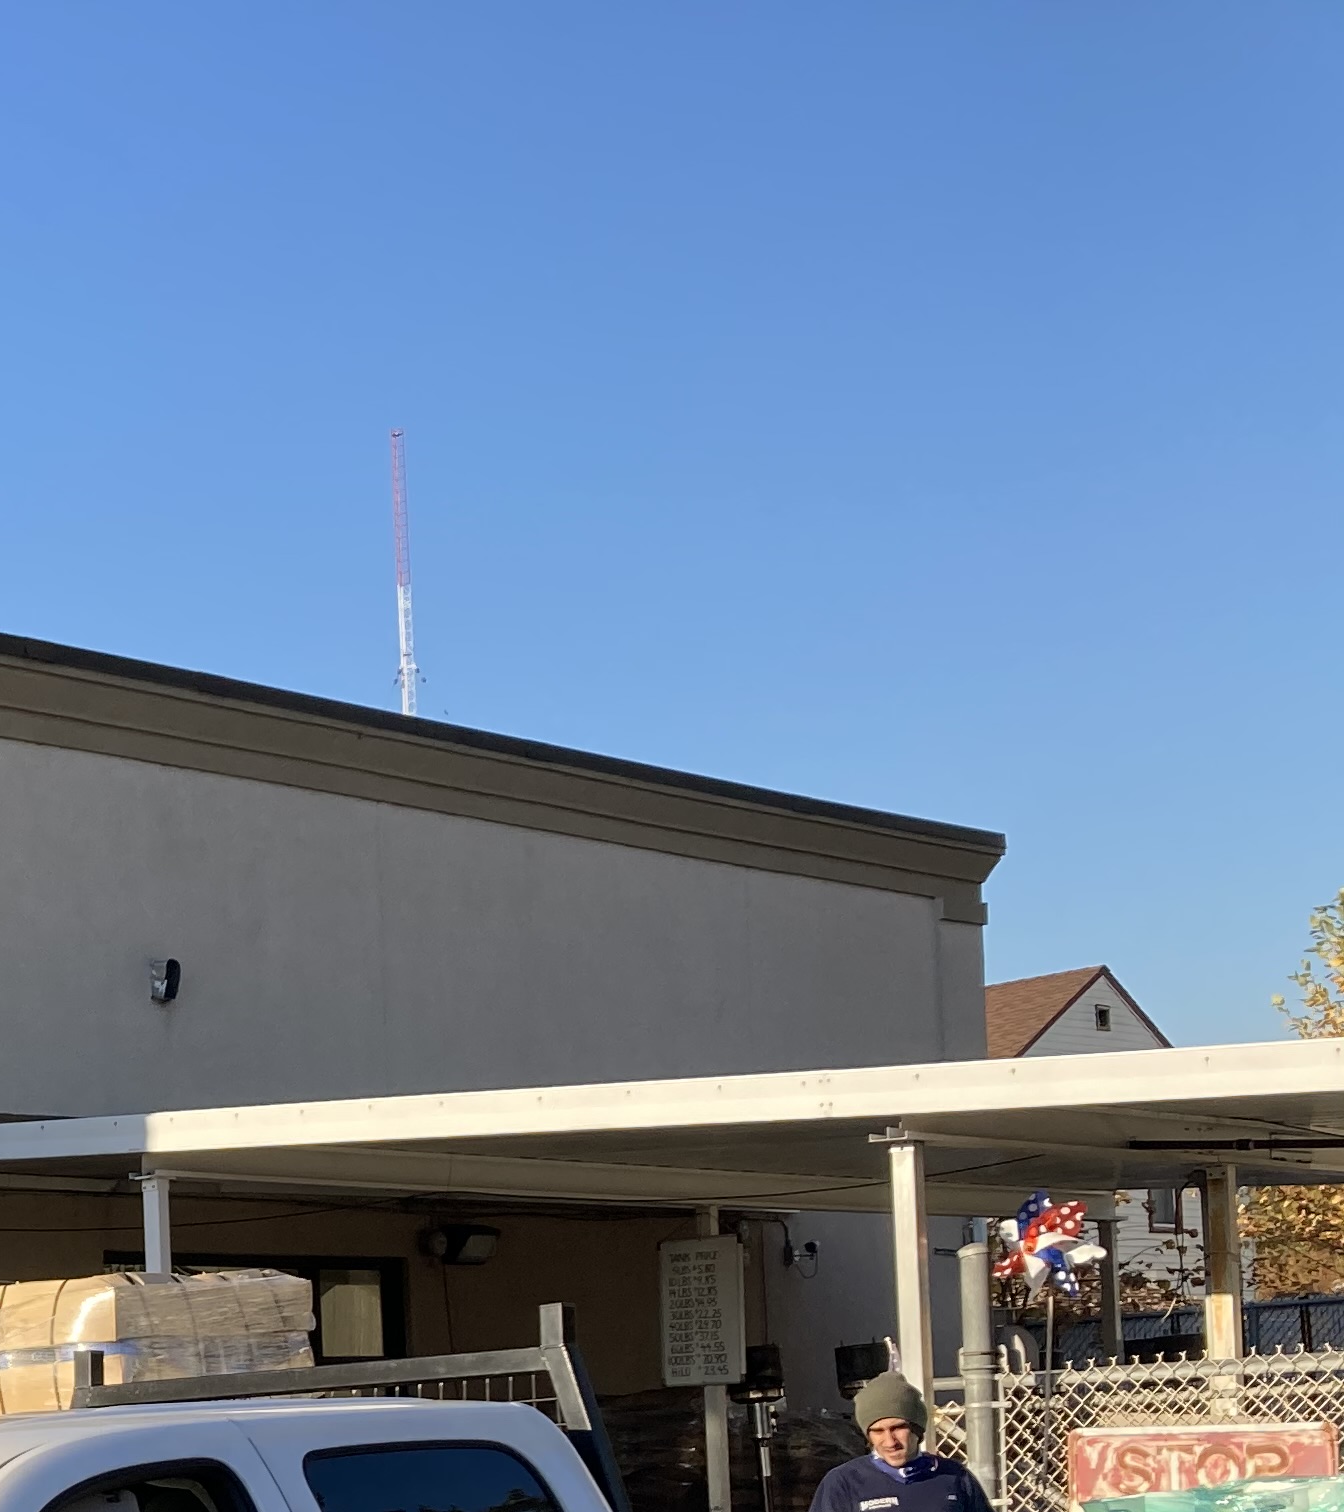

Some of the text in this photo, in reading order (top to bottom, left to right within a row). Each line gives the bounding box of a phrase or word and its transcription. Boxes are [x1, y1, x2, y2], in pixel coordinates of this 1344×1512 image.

[669, 1332, 694, 1343] 50LBS
[1116, 1443, 1293, 1494] STOP
[859, 1496, 899, 1511] MODERN
